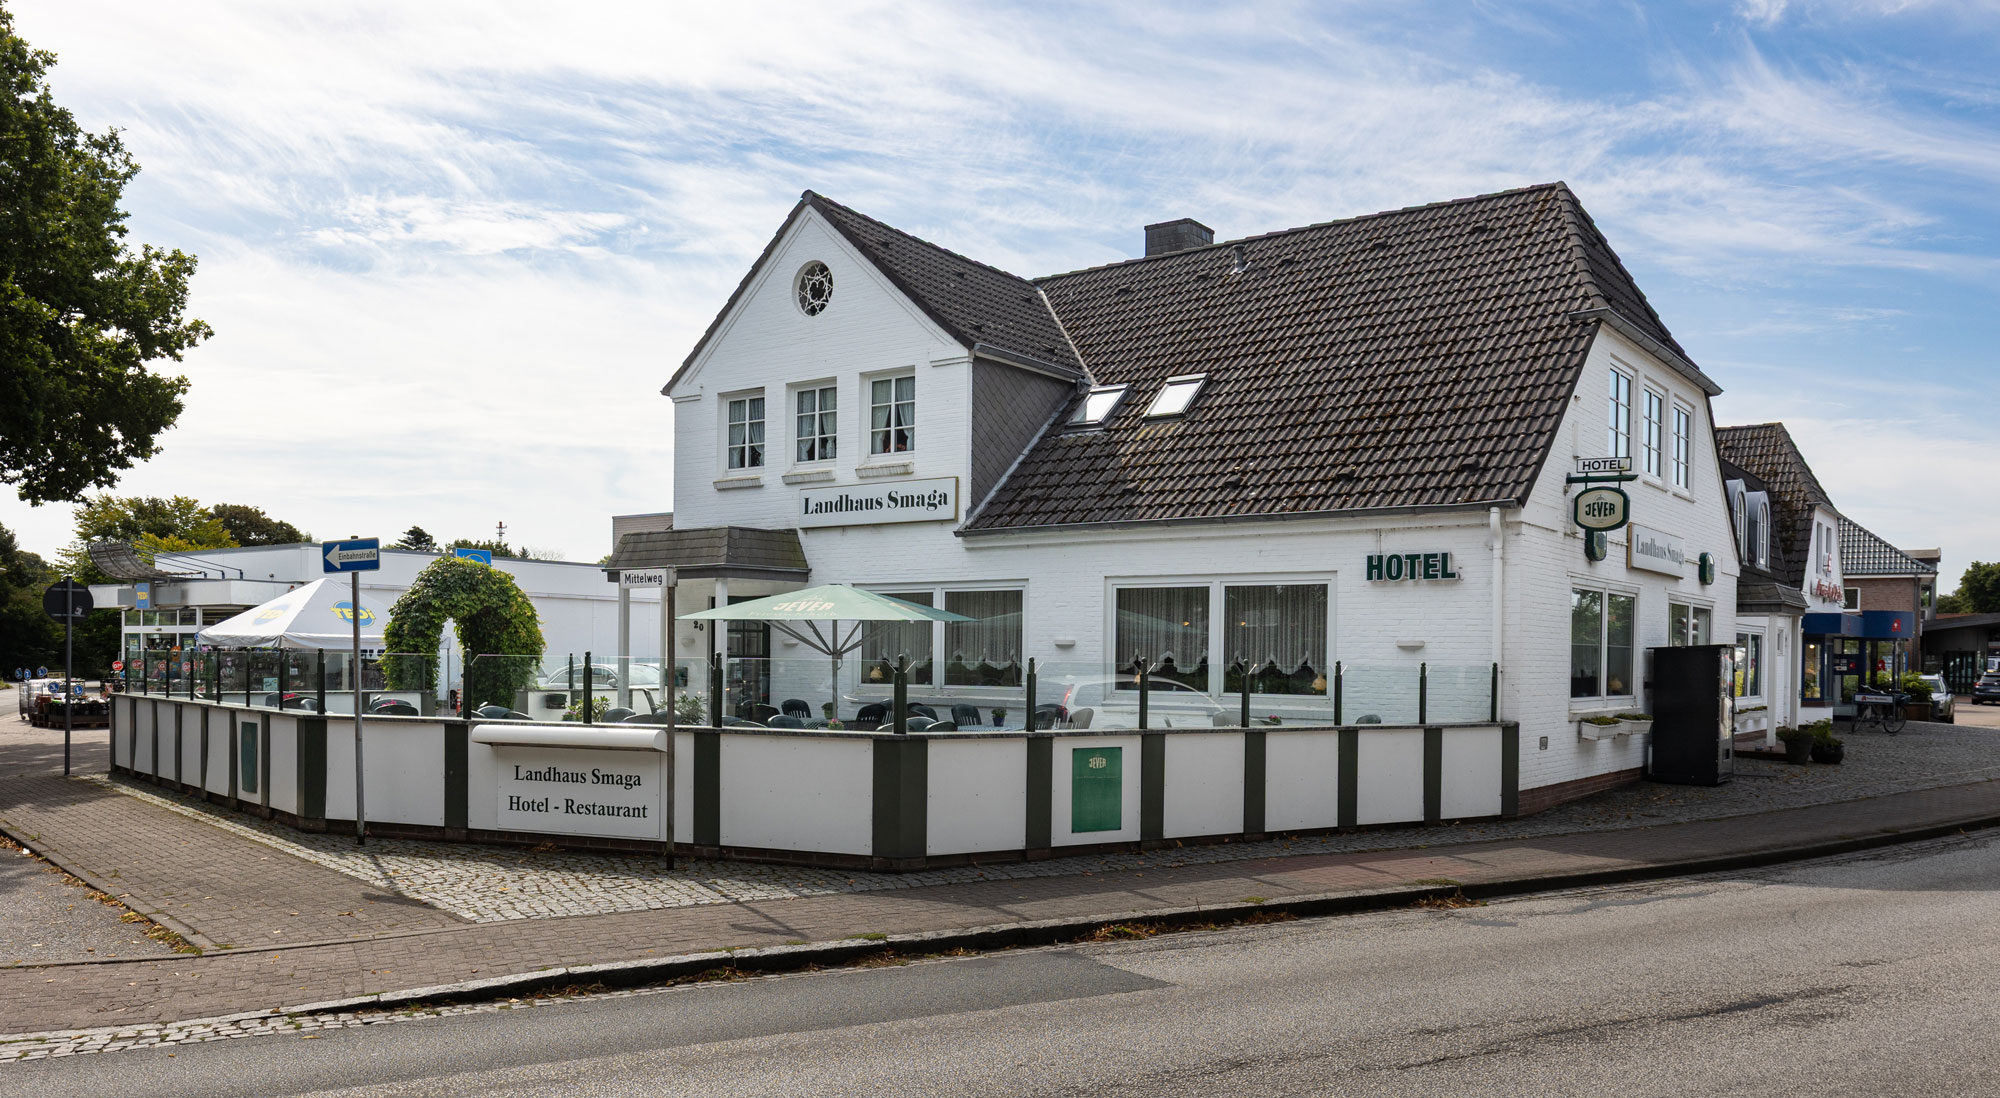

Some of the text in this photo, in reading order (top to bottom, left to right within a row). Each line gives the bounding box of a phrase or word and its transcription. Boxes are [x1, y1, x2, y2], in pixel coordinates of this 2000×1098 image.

[1582, 460, 1625, 470] HOTEL
[803, 489, 949, 515] Landhaus Smaga
[1585, 502, 1616, 517] JEVER
[1635, 534, 1667, 560] Landhaus
[338, 550, 376, 561] Einbahnstraße
[1366, 552, 1457, 580] HOTEL
[624, 573, 663, 586] Mittelweg
[772, 601, 836, 612] JEVER
[693, 620, 704, 632] 20
[1088, 756, 1107, 769] JEVER
[514, 765, 642, 790] Landhaus Smaga
[508, 795, 550, 813] Hotel
[564, 798, 648, 819] Restaurant
